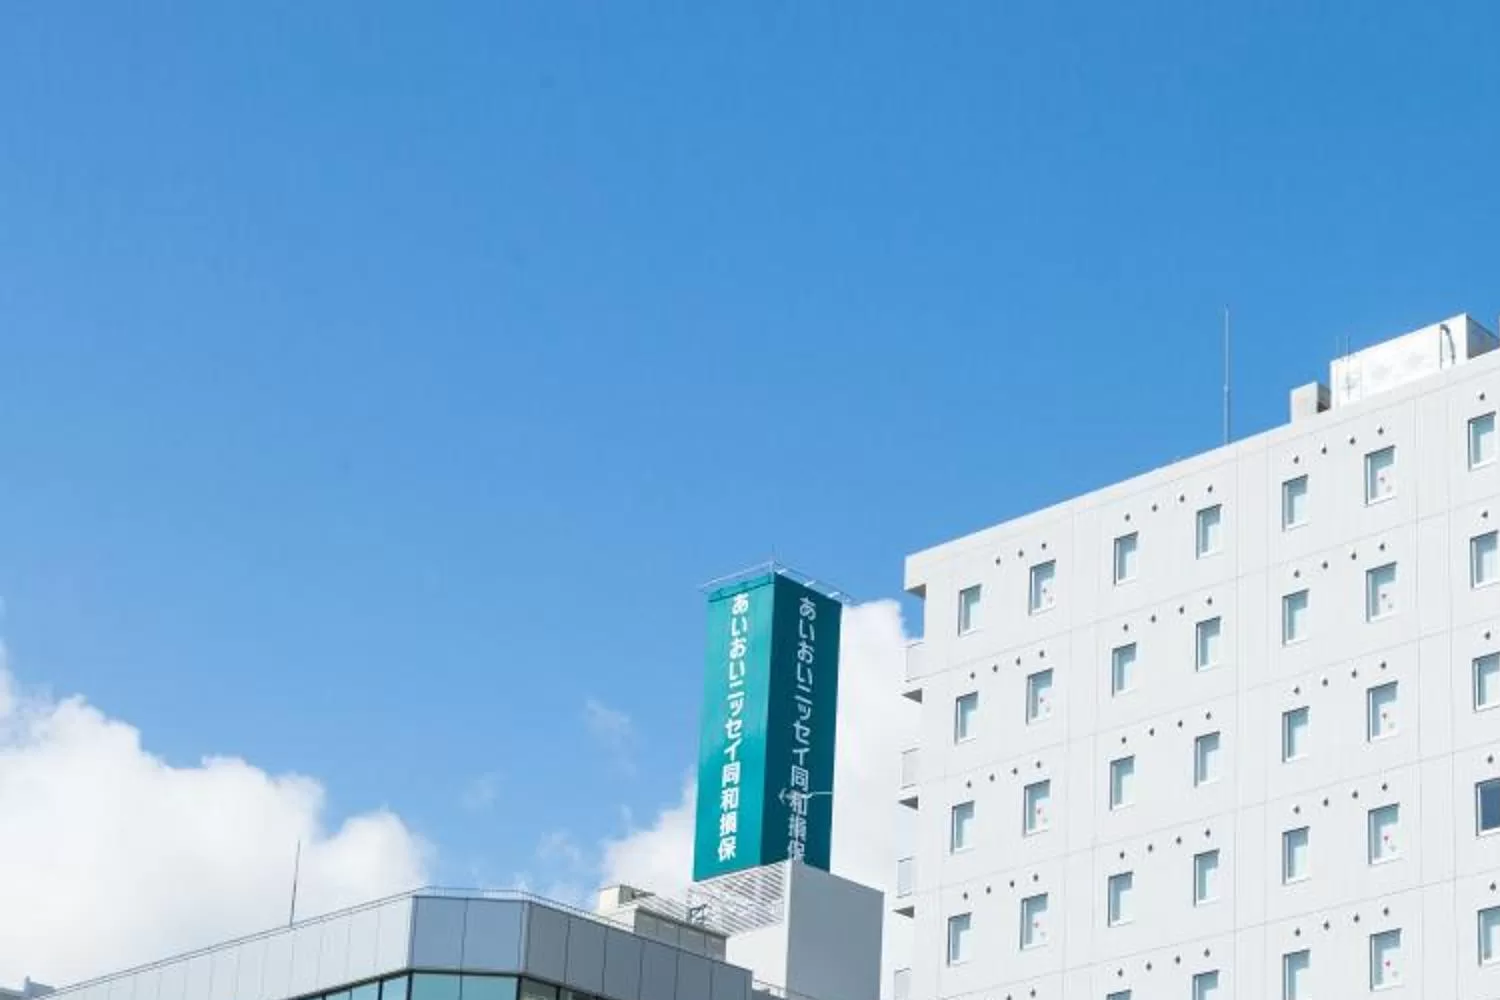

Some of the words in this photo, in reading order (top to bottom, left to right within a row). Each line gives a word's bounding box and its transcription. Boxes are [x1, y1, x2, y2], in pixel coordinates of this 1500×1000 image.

[717, 593, 748, 862] あいおいニッセイ同和損保
